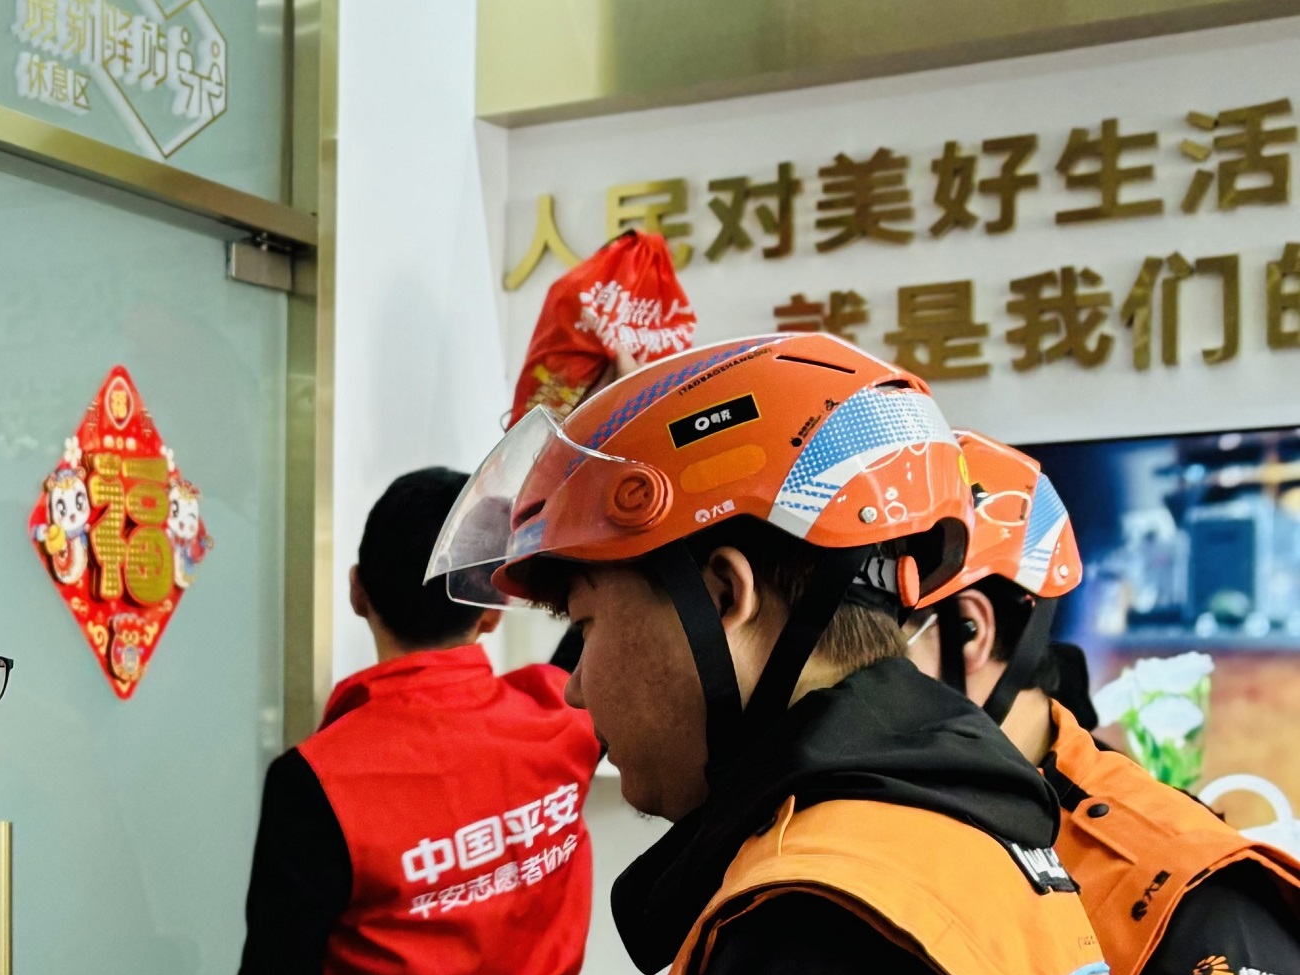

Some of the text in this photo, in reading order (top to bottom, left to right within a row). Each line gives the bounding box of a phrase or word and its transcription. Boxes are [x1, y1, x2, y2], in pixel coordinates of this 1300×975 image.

[22, 54, 91, 112] 休息区
[401, 782, 580, 885] 中国平安
[408, 833, 579, 919] 平安志愿者协会
